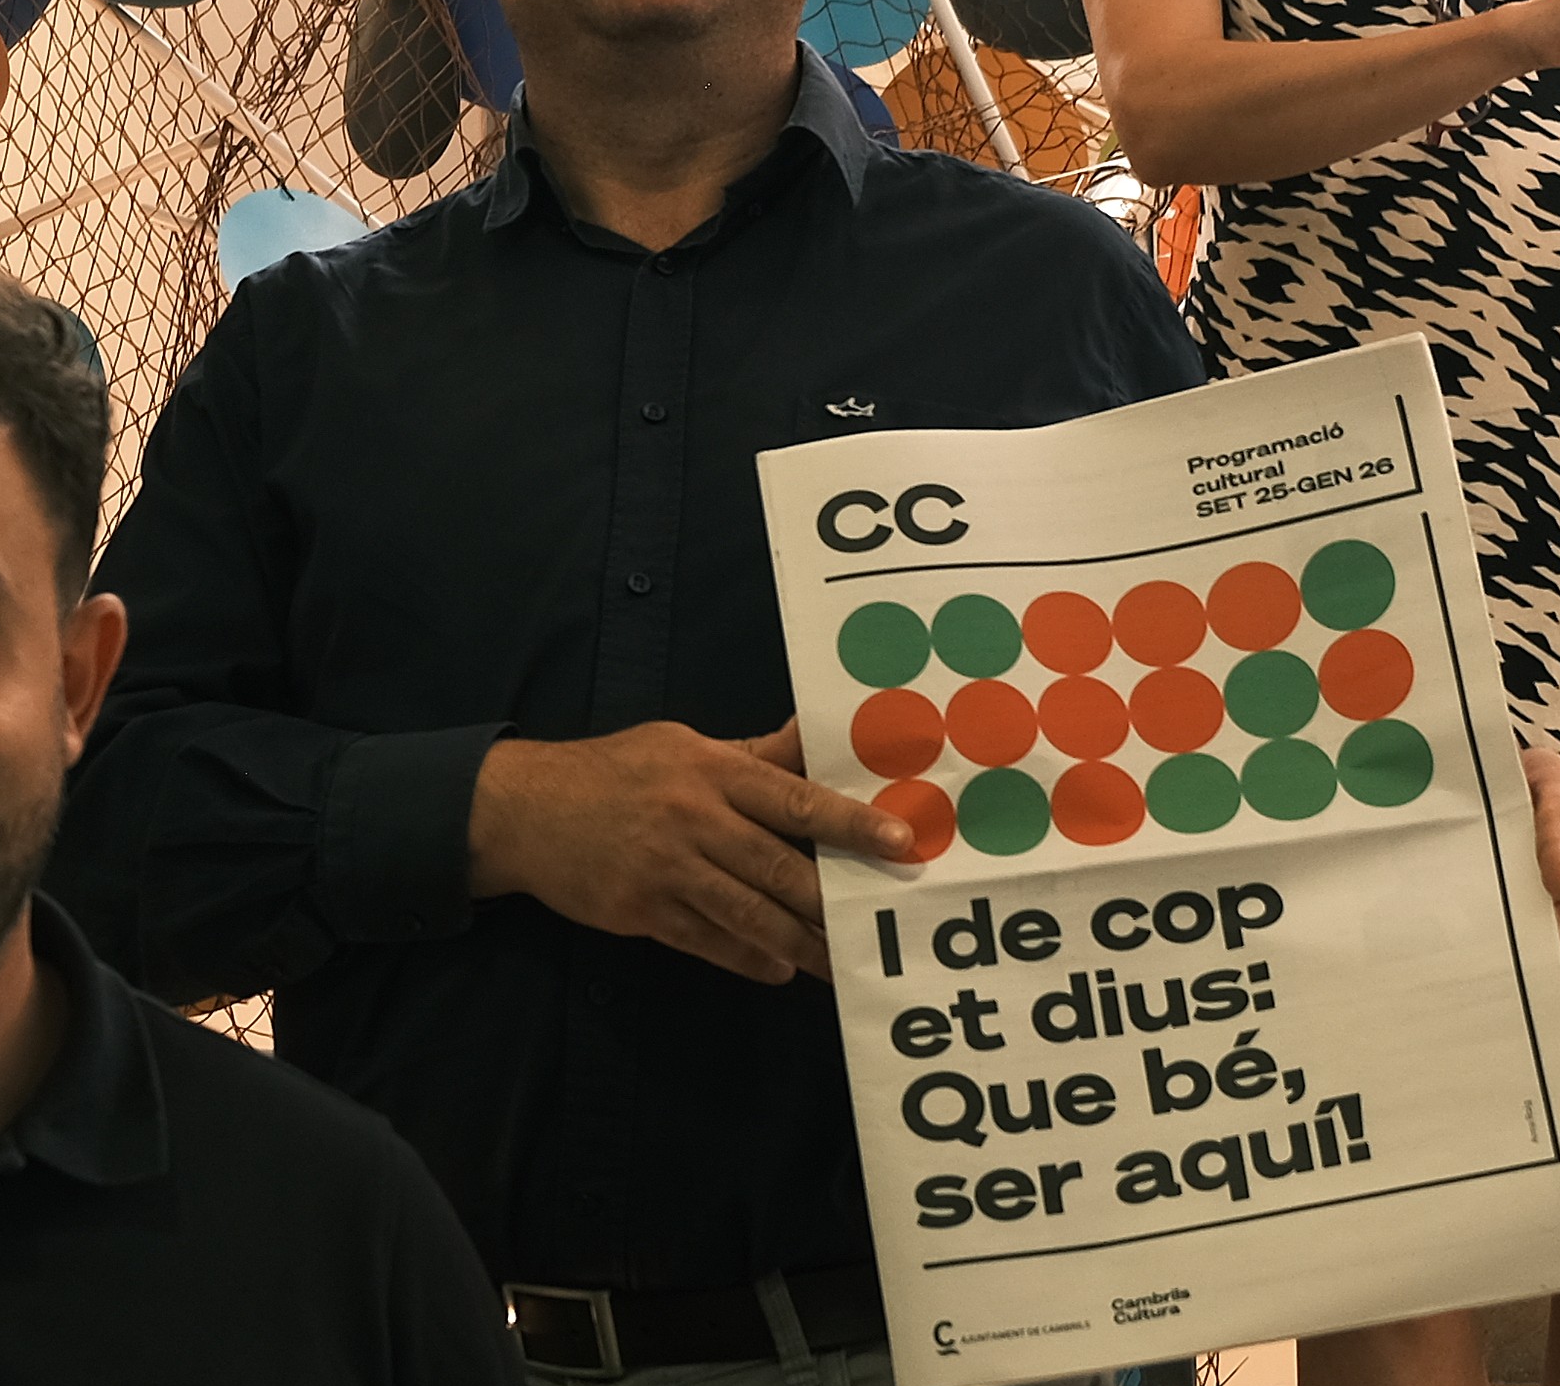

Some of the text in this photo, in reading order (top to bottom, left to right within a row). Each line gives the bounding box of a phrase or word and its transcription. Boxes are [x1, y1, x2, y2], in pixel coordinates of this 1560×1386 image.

[1186, 421, 1345, 475] Programació
[1192, 460, 1285, 496] cultural
[816, 483, 969, 552] CC
[1196, 457, 1395, 518] SET 25-GEN 26
[876, 882, 1284, 976] I de cop
[890, 960, 1277, 1058] et dius:
[900, 1032, 1306, 1149] Que bé,
[914, 1093, 1371, 1229] ser aquí!
[1111, 1287, 1191, 1312] Cambrils
[1112, 1304, 1181, 1325] Cultura
